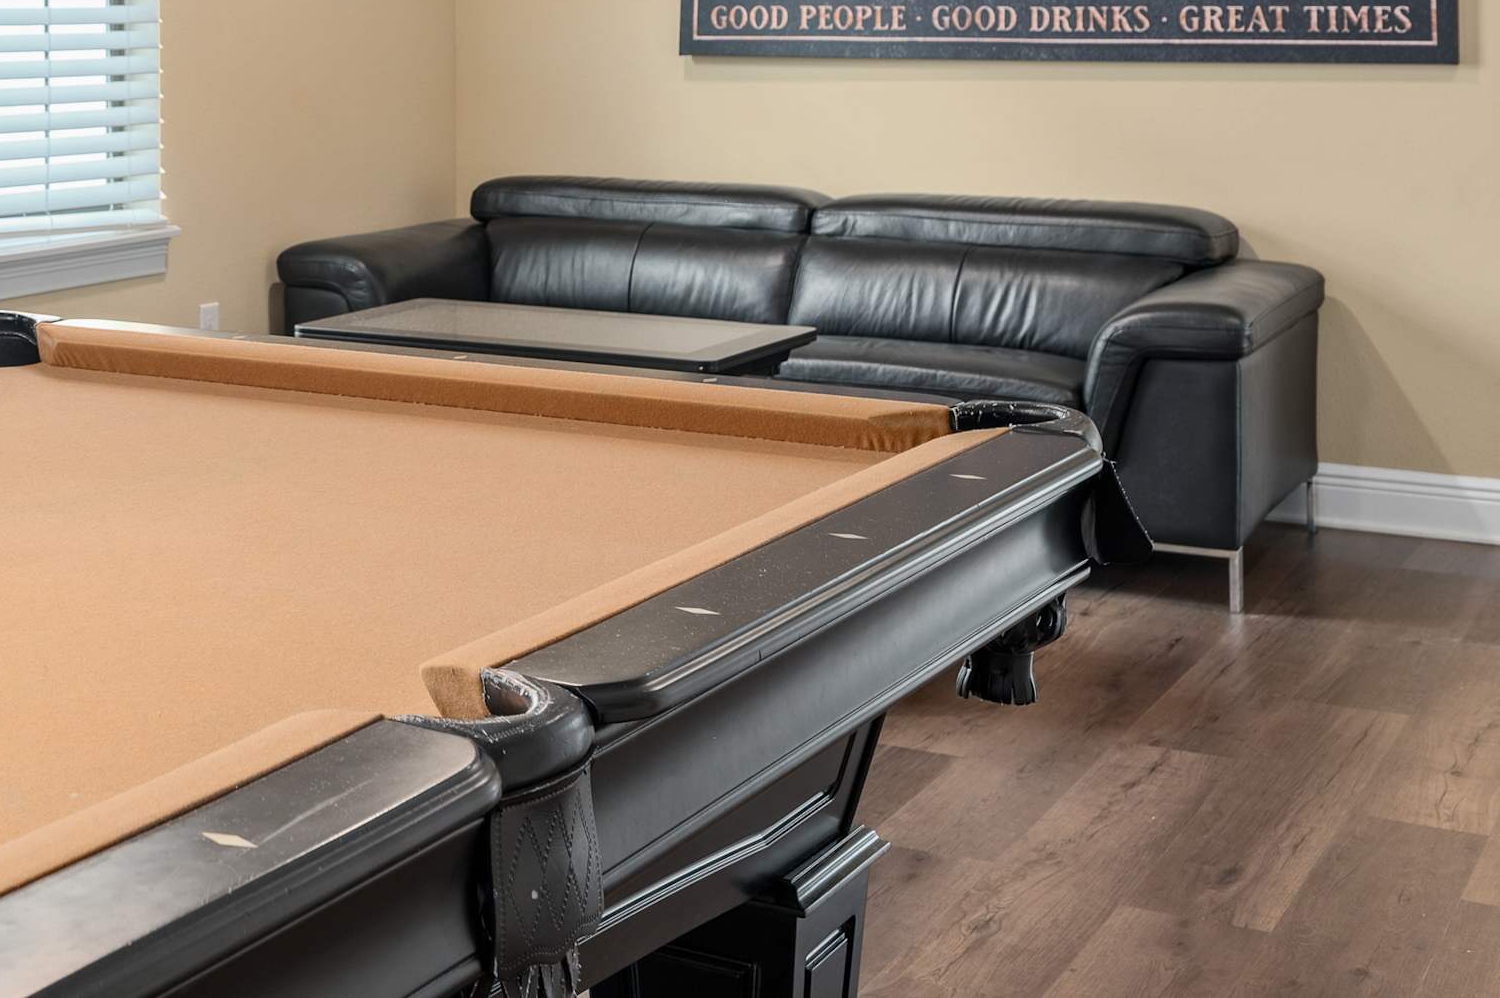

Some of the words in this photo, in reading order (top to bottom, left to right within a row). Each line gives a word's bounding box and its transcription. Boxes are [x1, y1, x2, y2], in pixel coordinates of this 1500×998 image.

[710, 5, 789, 31] GOOD
[799, 5, 907, 31] PEOPLE
[931, 5, 1018, 32] GOOD
[1029, 5, 1151, 33] DRINKS
[1179, 5, 1290, 34] GREAT
[1303, 5, 1413, 34] TIMES
